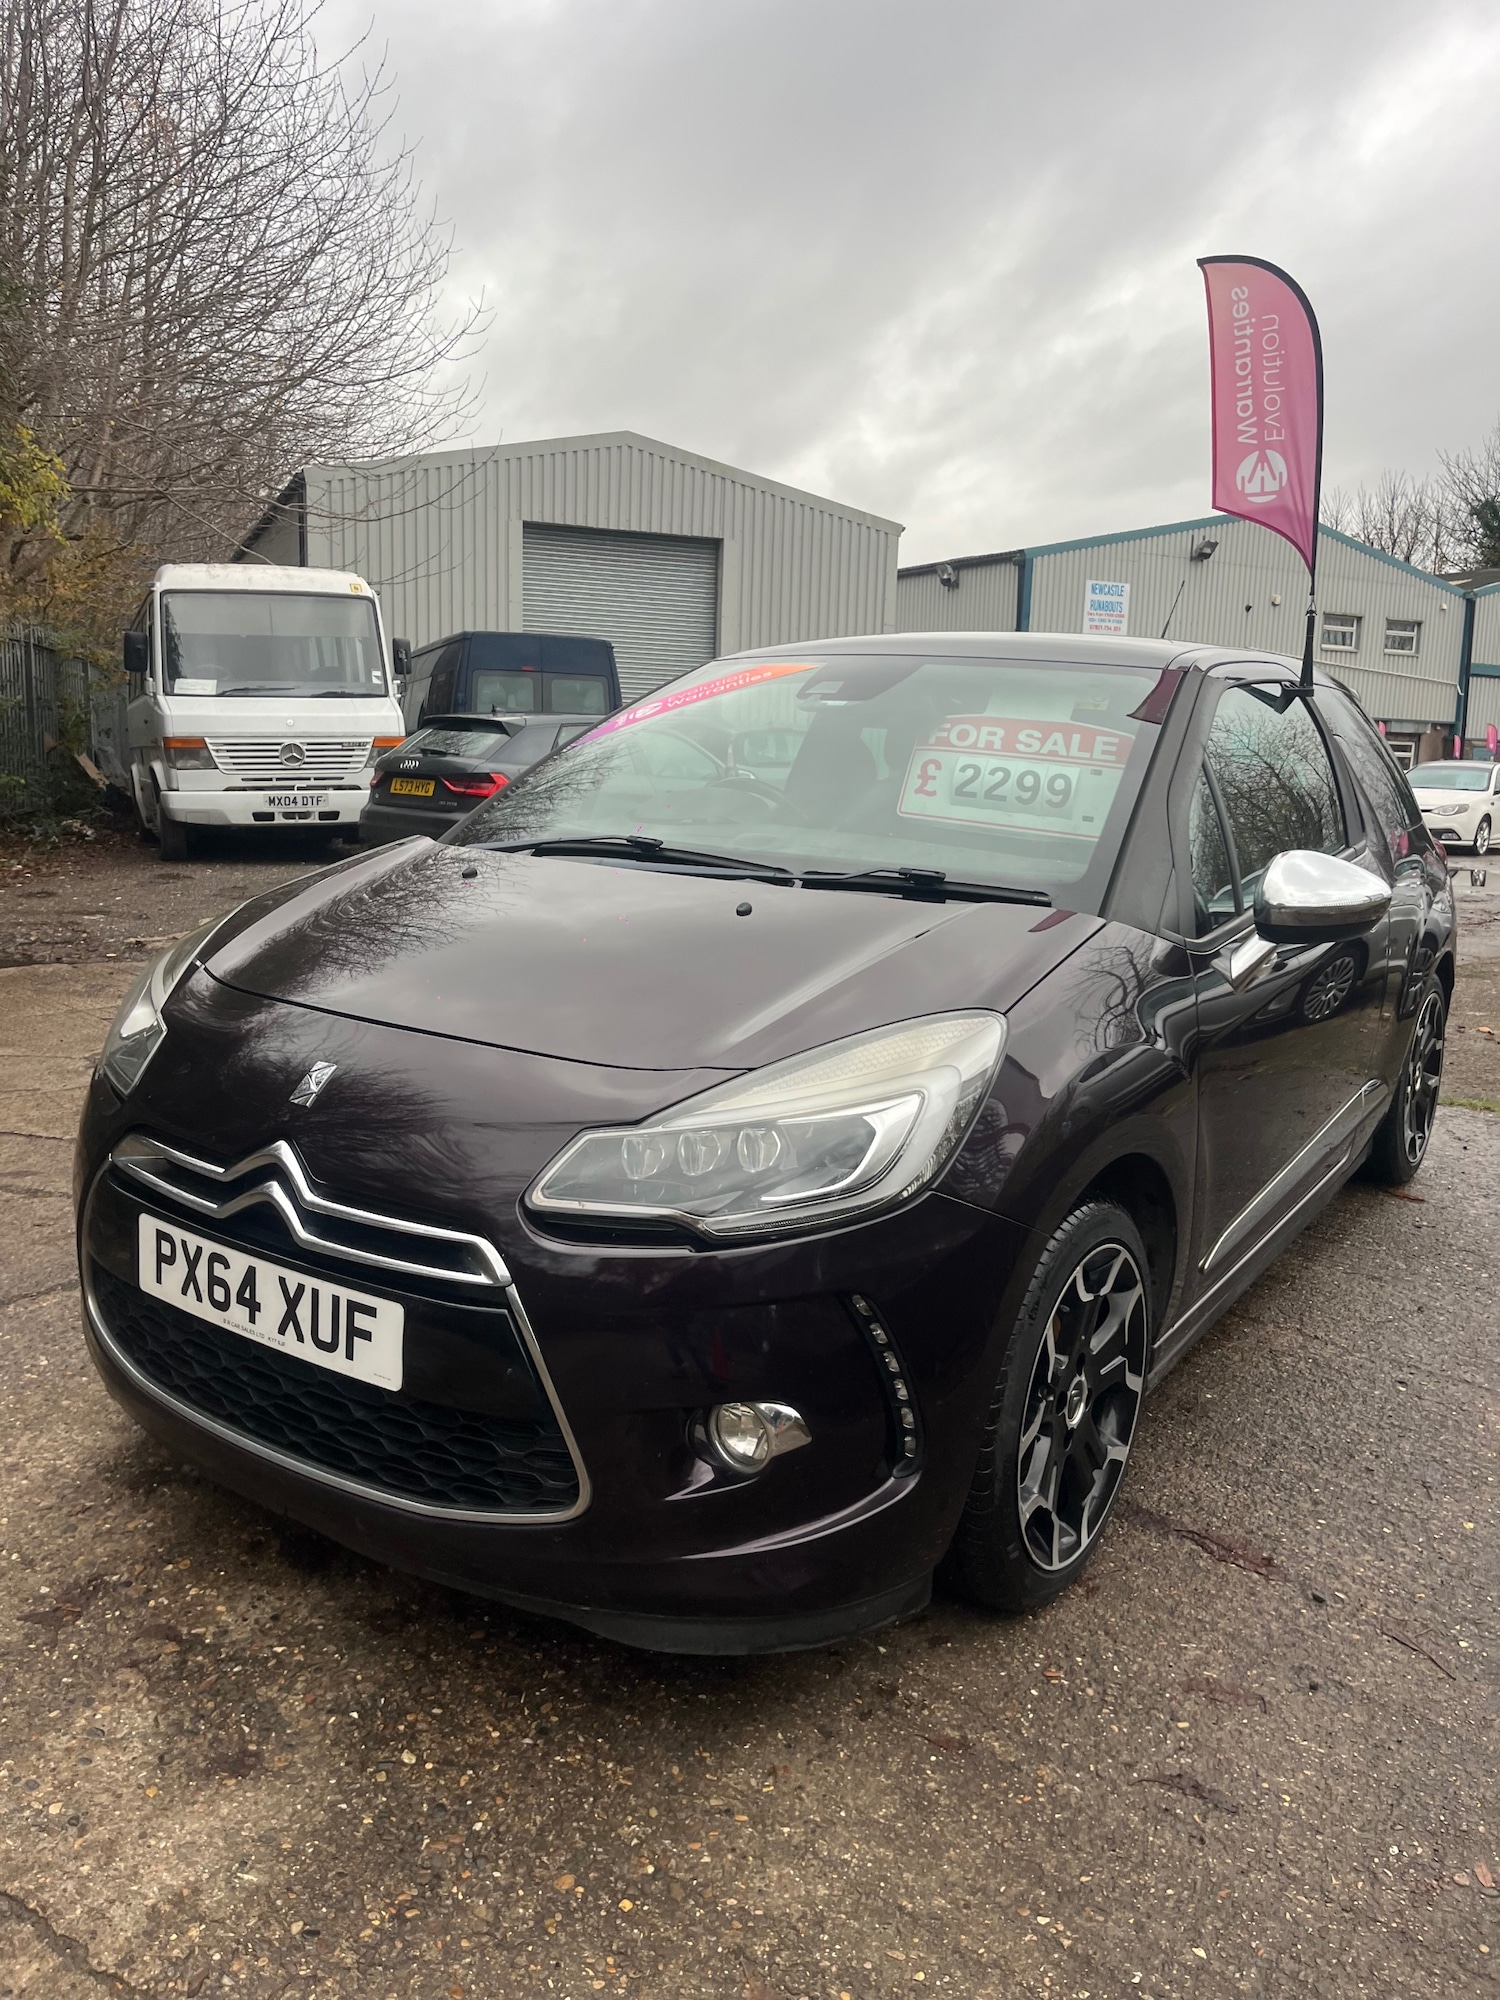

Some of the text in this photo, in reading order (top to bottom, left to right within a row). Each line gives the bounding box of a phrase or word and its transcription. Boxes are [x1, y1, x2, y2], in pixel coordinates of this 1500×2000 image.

[1091, 583, 1124, 596] NEWCASTLE
[1090, 600, 1122, 613] RUNABOUTS
[667, 672, 772, 707] Warranties
[668, 673, 749, 702] Evolution
[928, 723, 1120, 761] FOR SALE
[393, 779, 430, 794] LS73 HYG
[914, 758, 1073, 809] £ 2299
[268, 796, 324, 806] MX04 DTF
[155, 1228, 378, 1362] PX64 XUF
[241, 1325, 256, 1336] SALES
